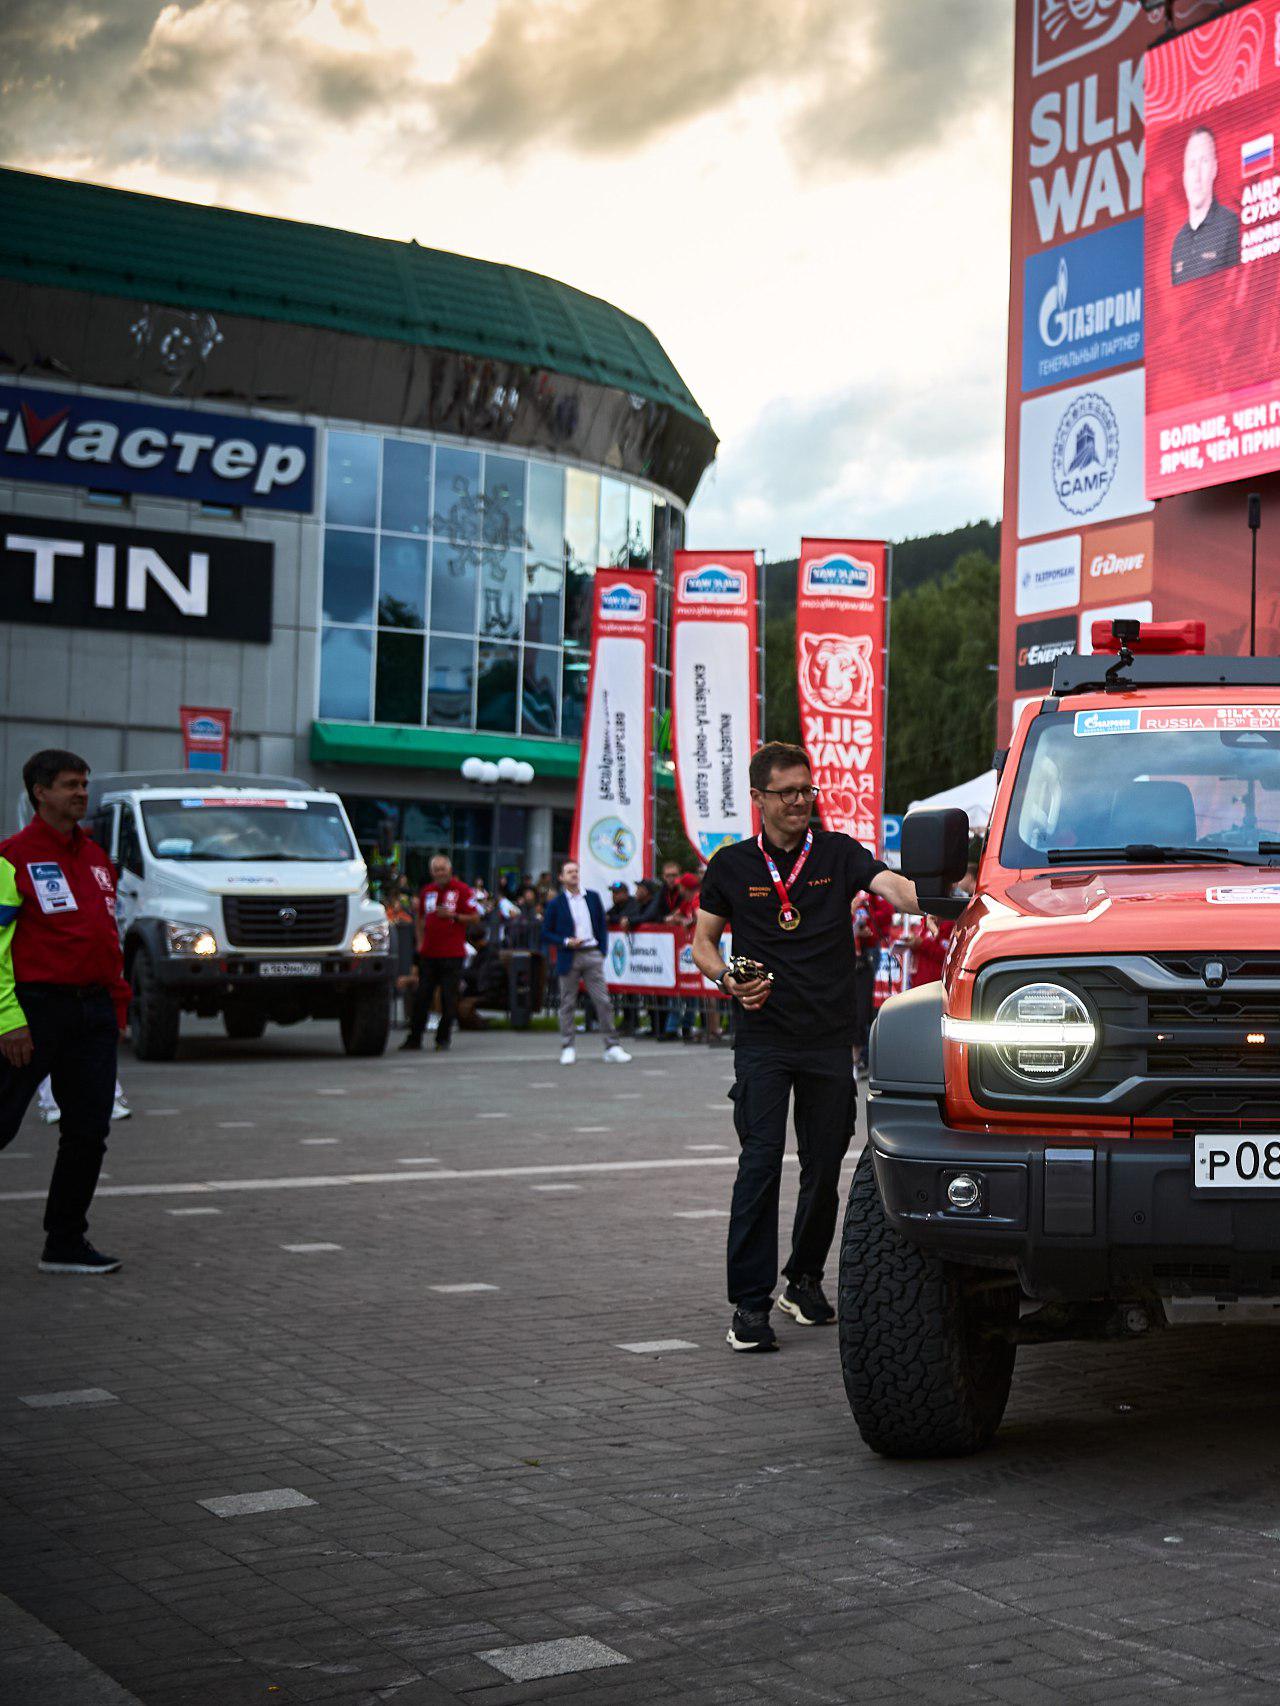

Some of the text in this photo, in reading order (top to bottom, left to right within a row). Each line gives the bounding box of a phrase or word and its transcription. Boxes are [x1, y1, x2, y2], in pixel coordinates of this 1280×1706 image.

[1029, 54, 1145, 168] SILK
[1029, 138, 1146, 243] WAY
[1067, 287, 1141, 342] ГАЗПРОМ
[1160, 415, 1231, 451] БОЛЬШЕ,
[1233, 403, 1267, 431] ЧЕМ
[1160, 446, 1204, 475] ЯРЧЕ,
[1206, 437, 1239, 463] ЧЕМ
[1146, 718, 1204, 728] RUSSIA
[1222, 718, 1245, 728] 15th
[1217, 709, 1254, 718] SILK
